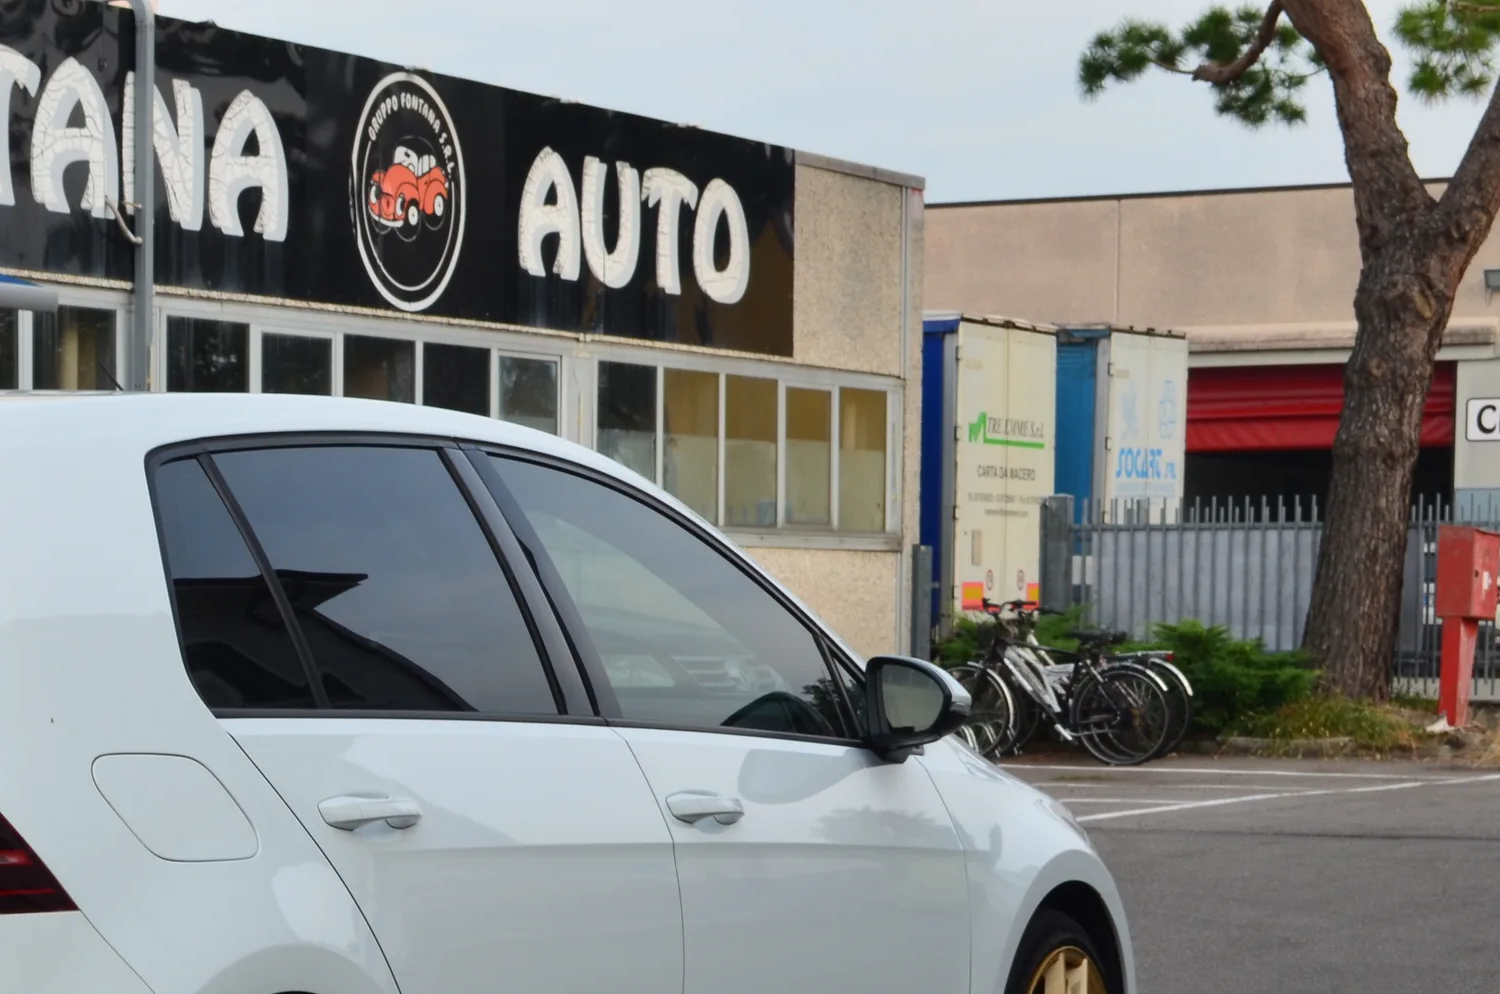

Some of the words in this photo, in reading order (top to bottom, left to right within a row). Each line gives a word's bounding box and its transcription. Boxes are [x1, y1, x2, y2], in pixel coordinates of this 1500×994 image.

[368, 94, 399, 141] GRUPPO
[400, 92, 440, 134] FONTANA
[518, 146, 751, 305] AUTO
[976, 464, 998, 478] CARTA
[999, 465, 1009, 480] DA
[1010, 467, 1036, 482] MACERO
